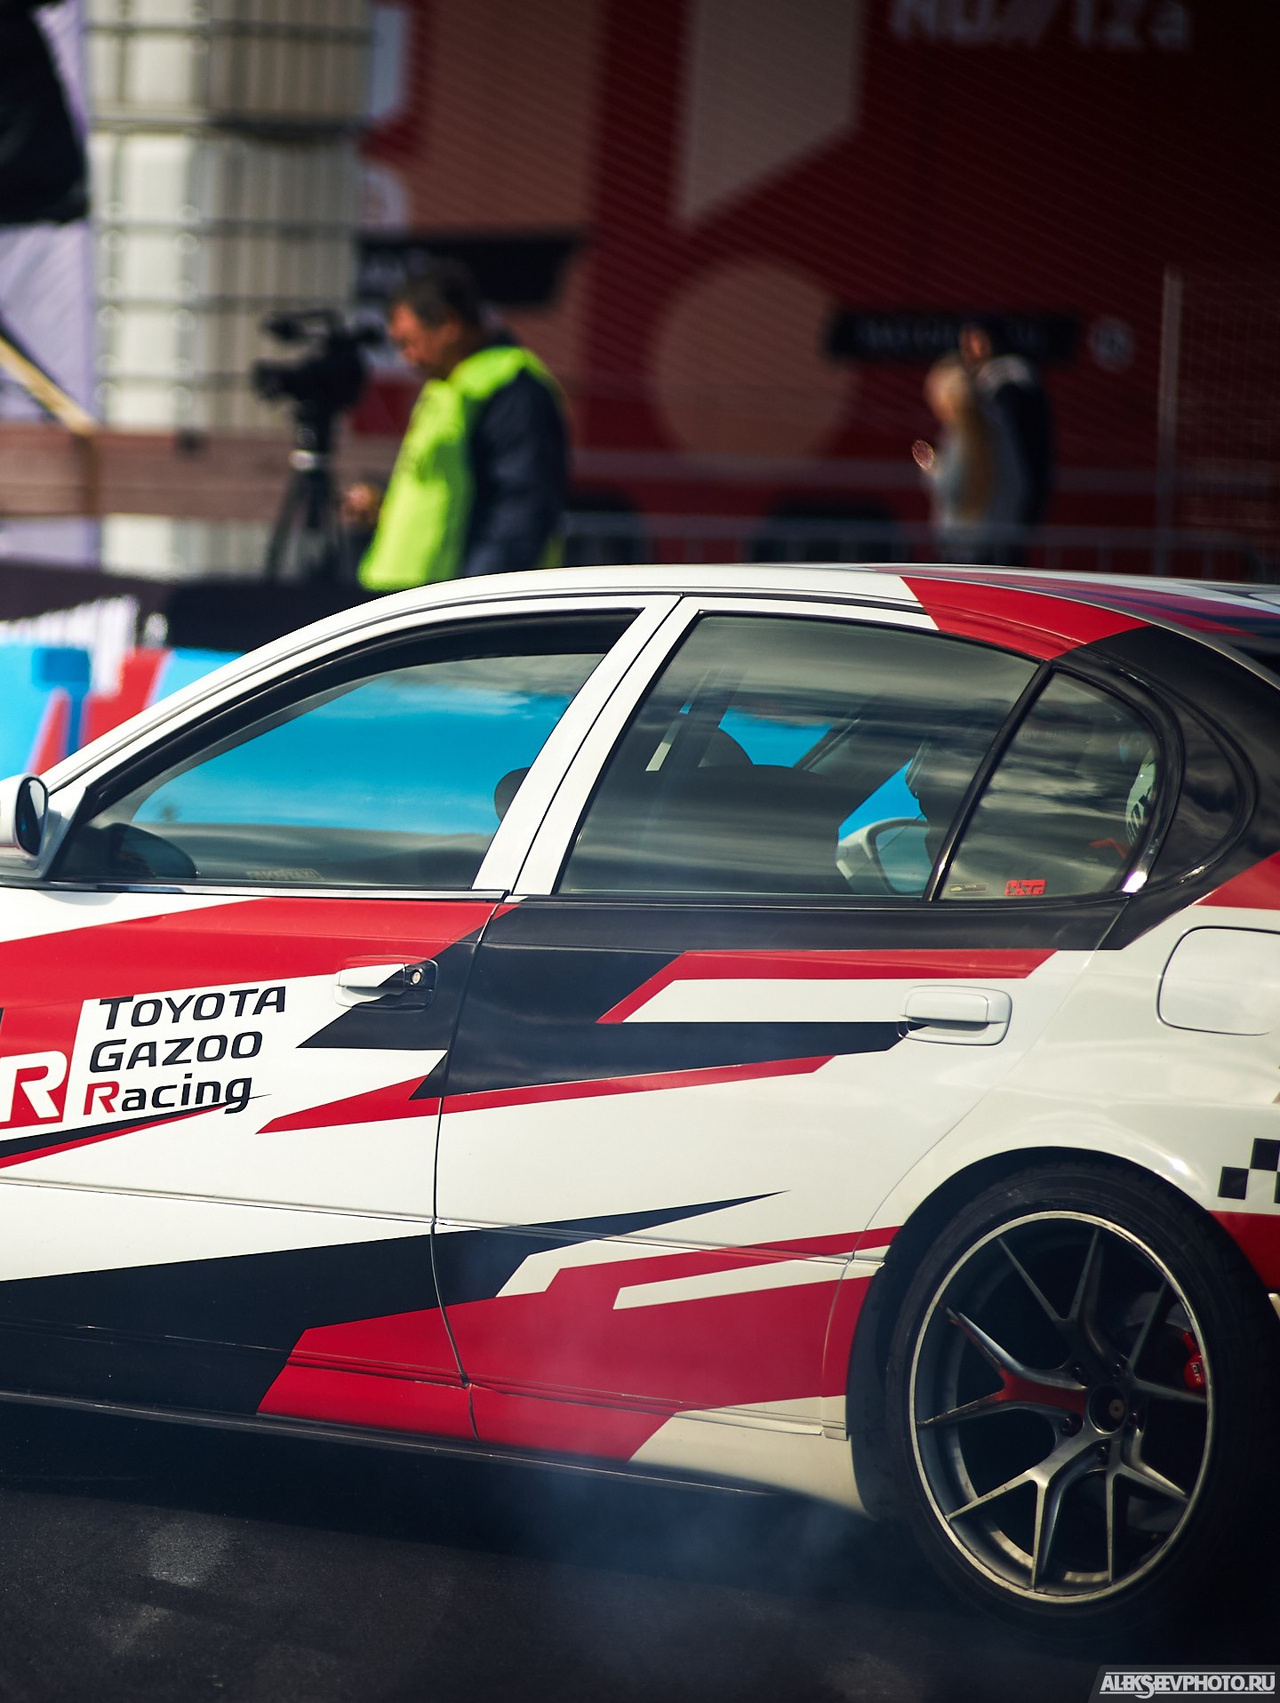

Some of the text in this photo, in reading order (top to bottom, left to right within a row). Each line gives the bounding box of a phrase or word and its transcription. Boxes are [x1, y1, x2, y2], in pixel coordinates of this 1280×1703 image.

[99, 986, 287, 1031] TOYOTA
[88, 1030, 263, 1074] GAZOO
[82, 1072, 253, 1115] Racing
